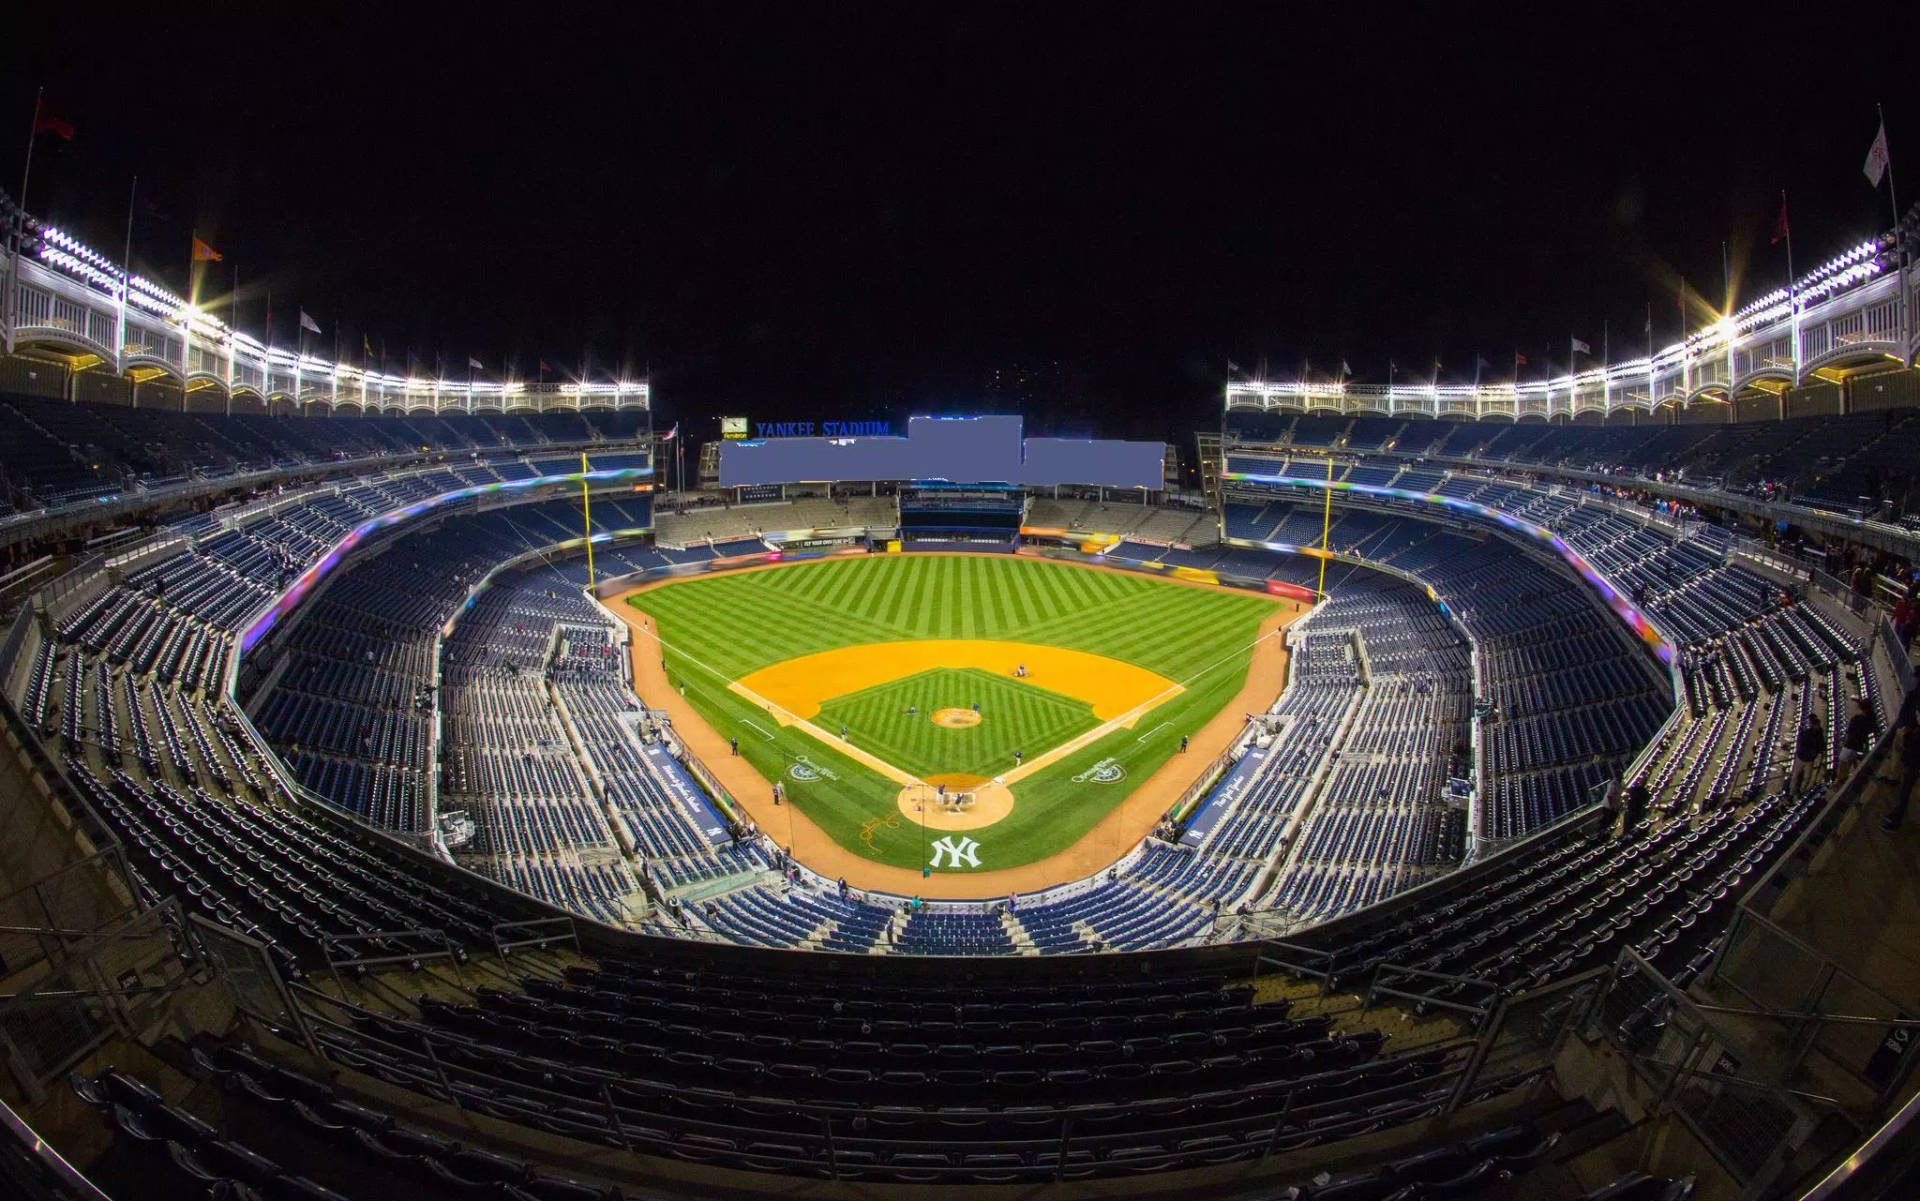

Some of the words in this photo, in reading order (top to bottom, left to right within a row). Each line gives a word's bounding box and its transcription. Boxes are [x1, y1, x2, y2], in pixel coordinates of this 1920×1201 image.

[756, 422, 815, 437] YANKEE
[822, 421, 889, 436] STADIUM
[929, 835, 982, 868] NY
